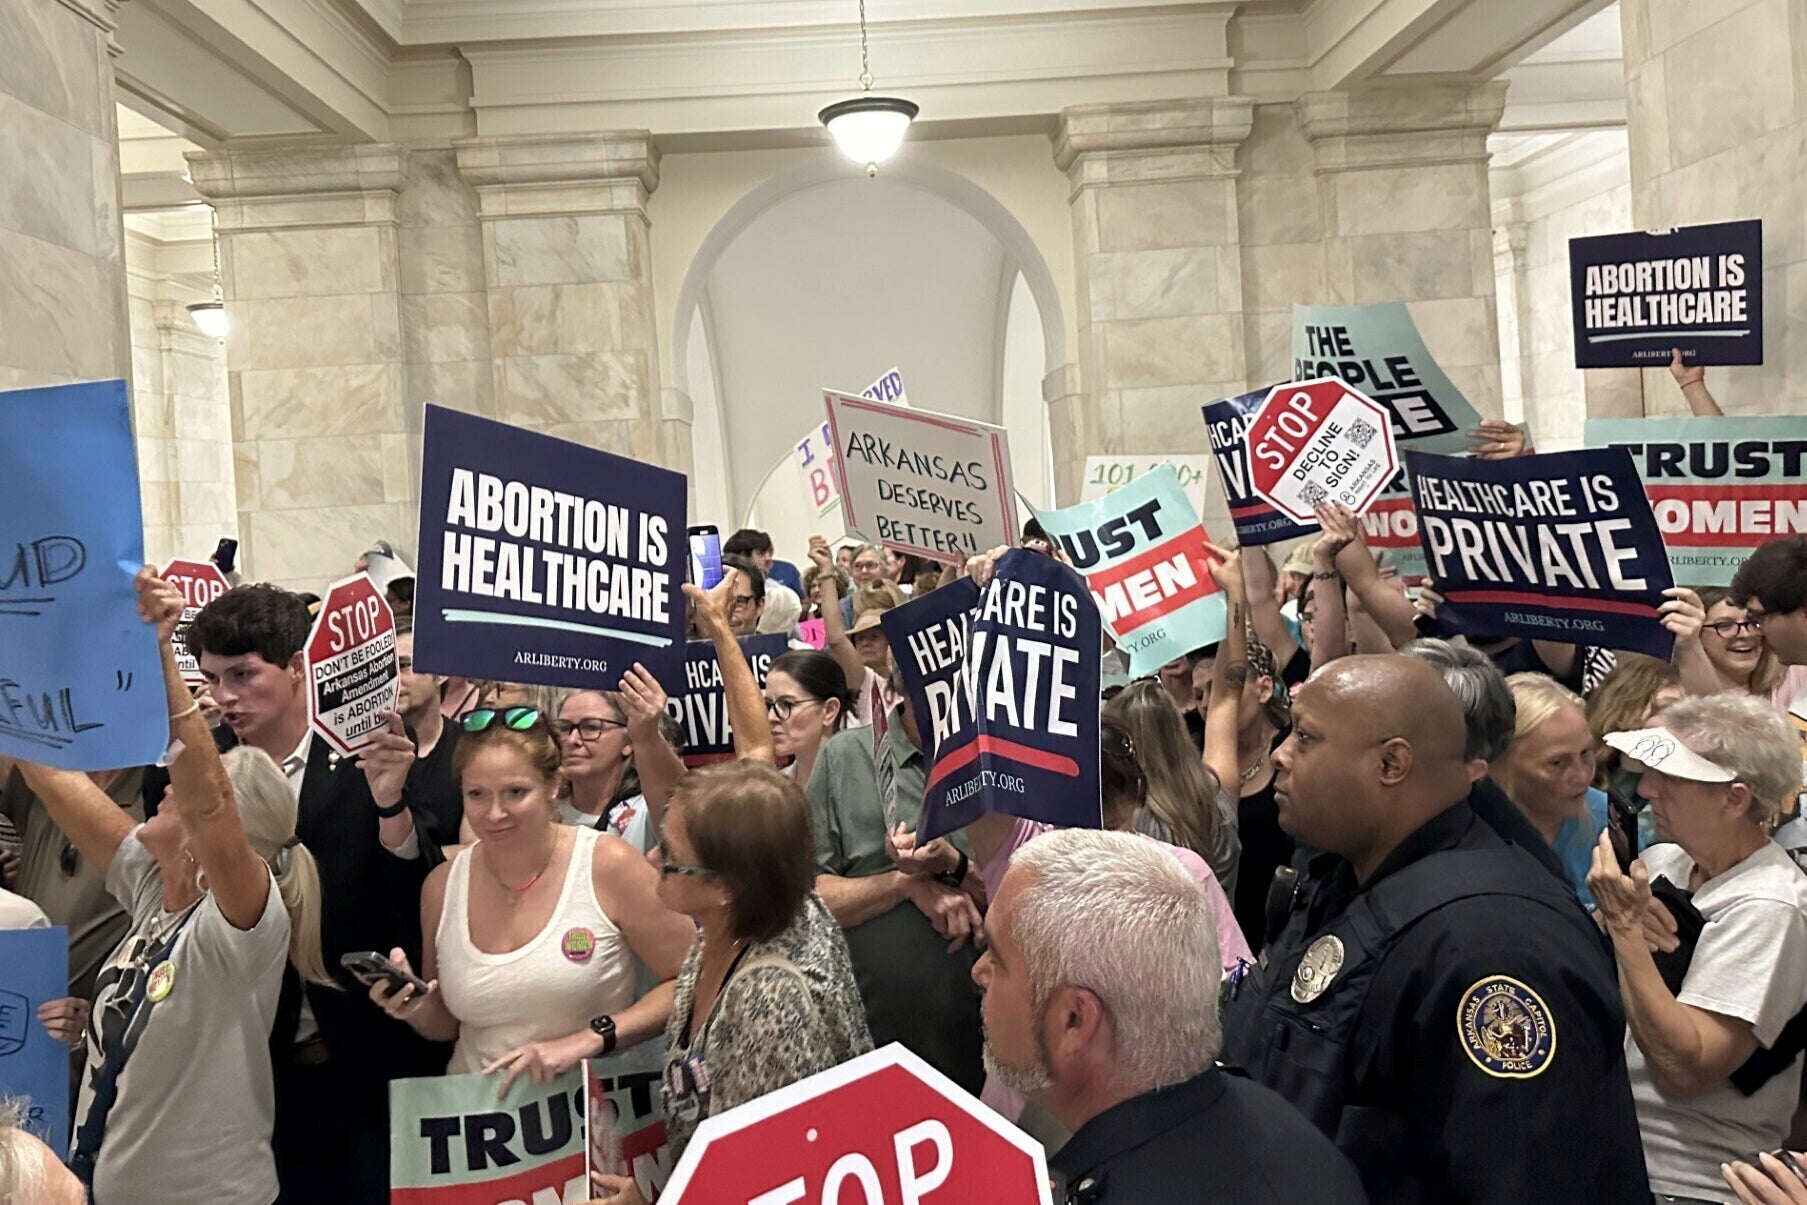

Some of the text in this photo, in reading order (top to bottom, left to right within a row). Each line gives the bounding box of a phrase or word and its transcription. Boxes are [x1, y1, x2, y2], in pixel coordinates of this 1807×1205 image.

[1586, 254, 1745, 296] ABORTION IS
[1585, 289, 1747, 329] HEALTHCARE
[1306, 325, 1355, 357] THE
[1256, 391, 1318, 470] STOP
[846, 432, 987, 491] ARKANSAS
[1293, 421, 1343, 481] DECLINE
[1318, 450, 1339, 470] TO
[1325, 449, 1361, 488] SIGN!
[1349, 459, 1376, 490] ARKANSAS
[877, 479, 983, 524] DESERVES
[1417, 475, 1577, 518] HEALTHCARE
[1580, 474, 1619, 514] IS
[446, 467, 669, 567] ABORTION IS
[1058, 498, 1162, 569] UST
[1650, 499, 1807, 534] OMEN
[1423, 516, 1648, 591] PRIVATE
[441, 530, 670, 624] HEALTHCARE
[328, 595, 379, 652] STOP
[1053, 591, 1077, 638] IS
[1504, 612, 1605, 632] ARLIBERTY.ORG
[315, 654, 349, 680] DON'T
[351, 649, 364, 664] BE
[323, 652, 394, 695] Arkansas Abortion
[513, 651, 608, 672] ARLIBERTY.ORG
[333, 712, 345, 726] is
[347, 686, 394, 721] ABORTION
[341, 673, 390, 703] Amendment
[345, 713, 371, 737] until
[1486, 984, 1516, 995] STATE
[1465, 995, 1480, 1050] ARKANSAS
[1525, 998, 1548, 1038] CAPITOL
[1502, 1060, 1533, 1070] POLICE
